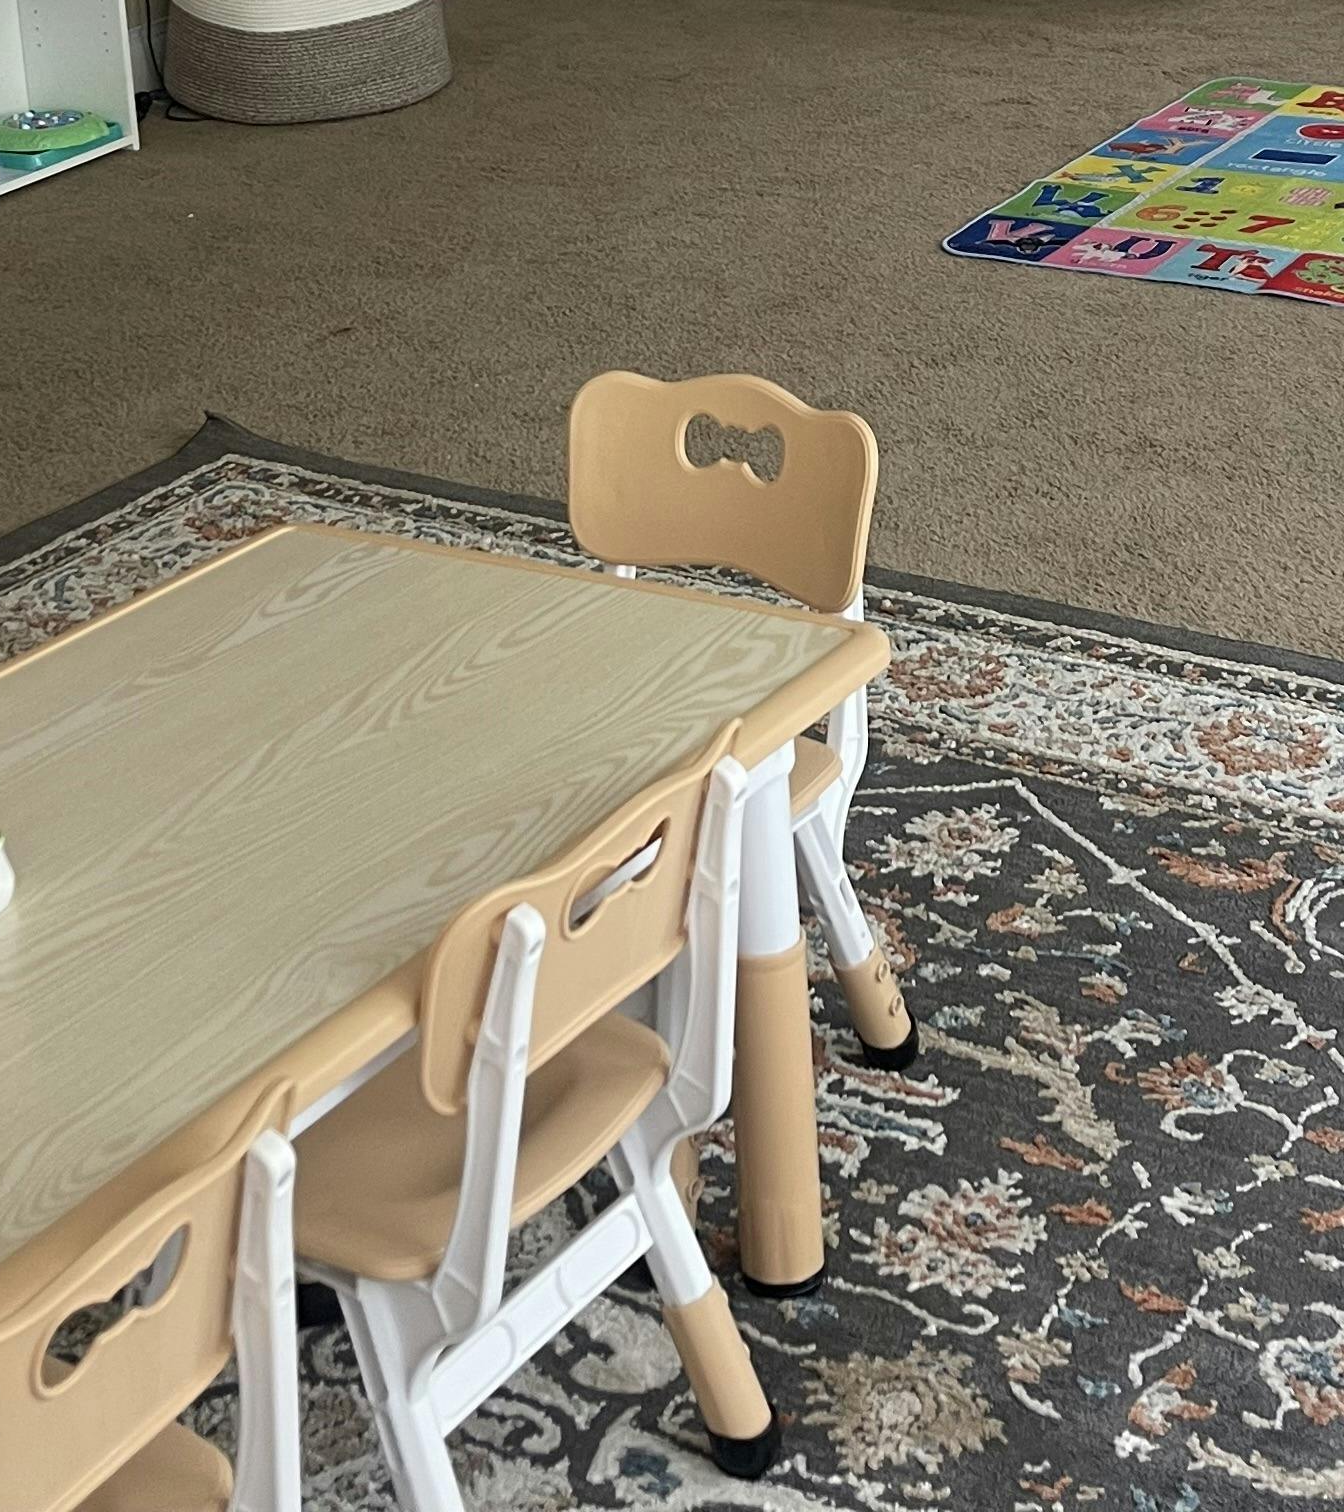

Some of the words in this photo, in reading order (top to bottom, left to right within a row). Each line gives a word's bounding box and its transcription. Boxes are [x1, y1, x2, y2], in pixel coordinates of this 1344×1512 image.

[1136, 204, 1188, 221] 6
[1238, 215, 1296, 234] 7
[1190, 243, 1259, 272] T
